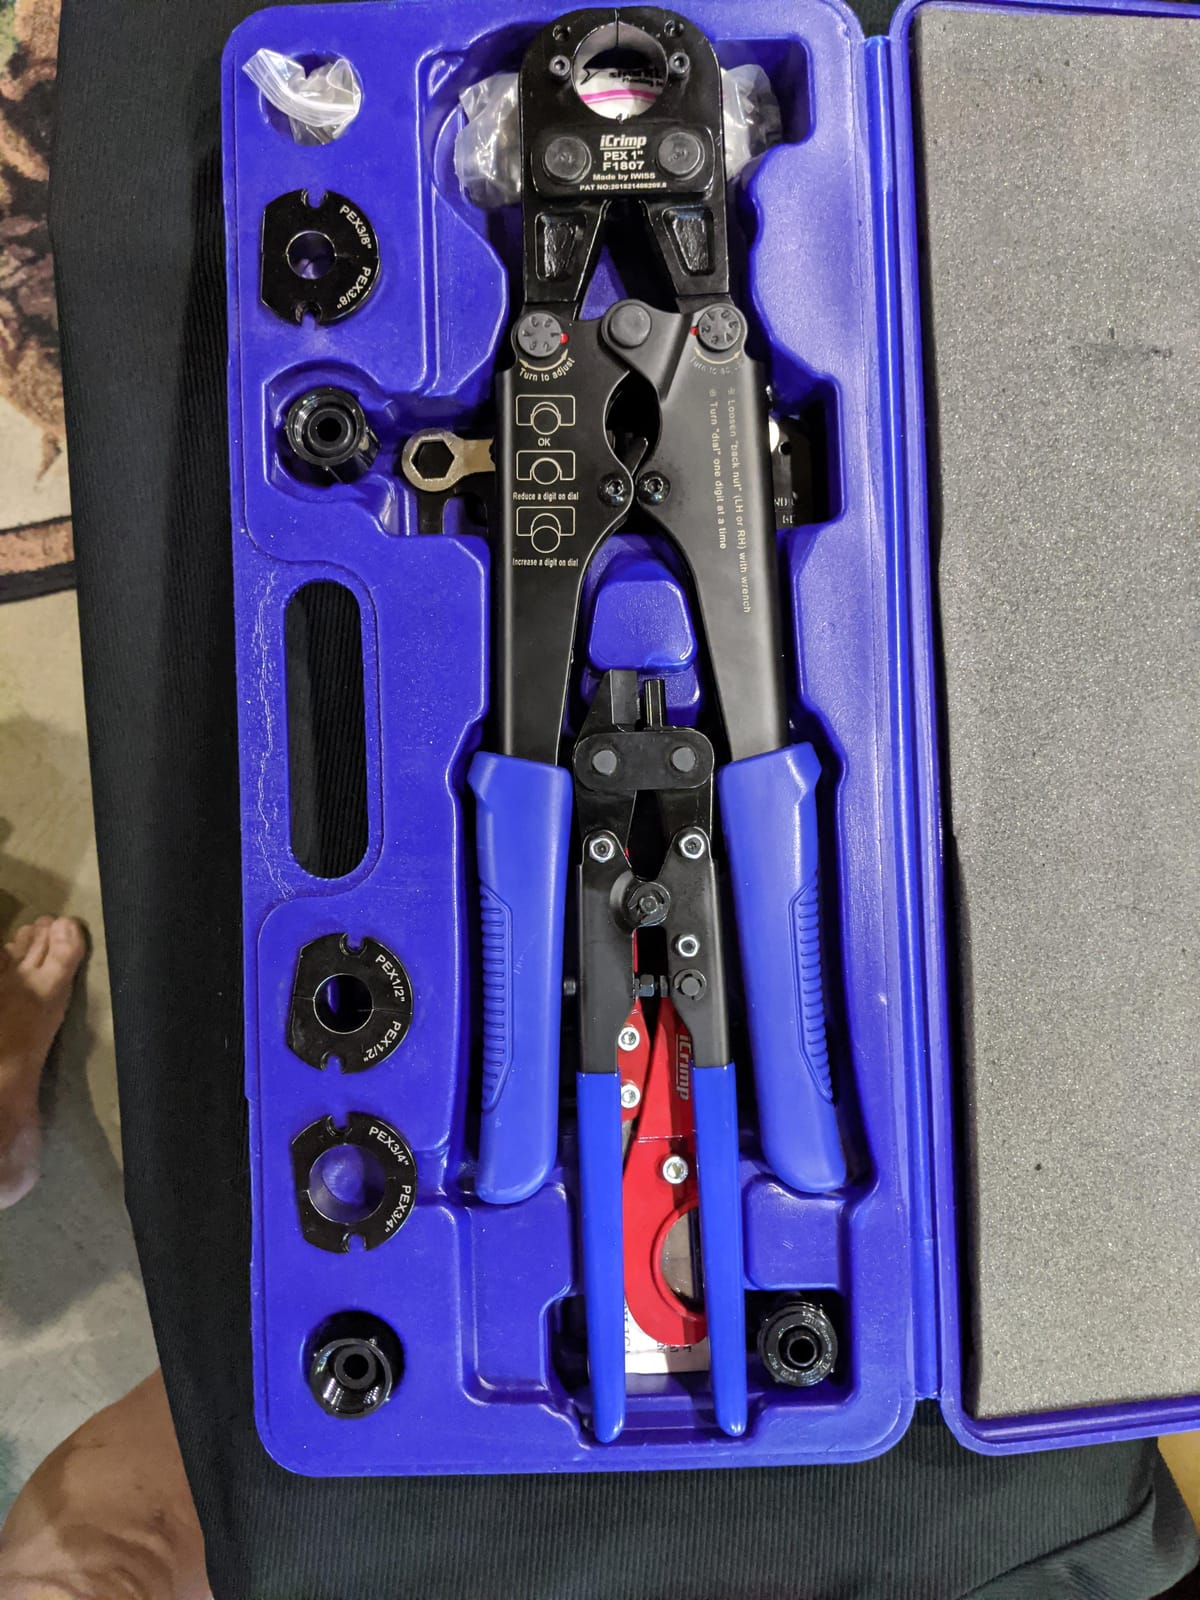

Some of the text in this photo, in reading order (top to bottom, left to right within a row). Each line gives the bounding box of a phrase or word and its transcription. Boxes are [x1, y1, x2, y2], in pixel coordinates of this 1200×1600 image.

[600, 134, 648, 150] iCrimp
[603, 150, 644, 161] PEX 1"
[592, 172, 656, 181] Made by IWISS
[603, 161, 645, 171] F1807
[339, 204, 372, 249] PEX3/8"
[336, 266, 372, 309] PEX3/8"
[519, 357, 575, 382] Turn to adjust
[537, 437, 551, 447] OK
[709, 401, 727, 549] Turn "dial" one digit at a time
[512, 491, 579, 503] Reduce a digit on dial
[727, 399, 751, 613] Loosen "back nut" (LH or RH) with wrench
[512, 557, 579, 569] Increase a digit on dial
[375, 954, 405, 1002] PEX1/2"
[363, 1020, 402, 1062] PEX1/2"
[676, 1034, 691, 1100] iCrimp
[368, 1126, 409, 1166] PEX3/4"
[385, 1185, 412, 1233] PEX3/4"
